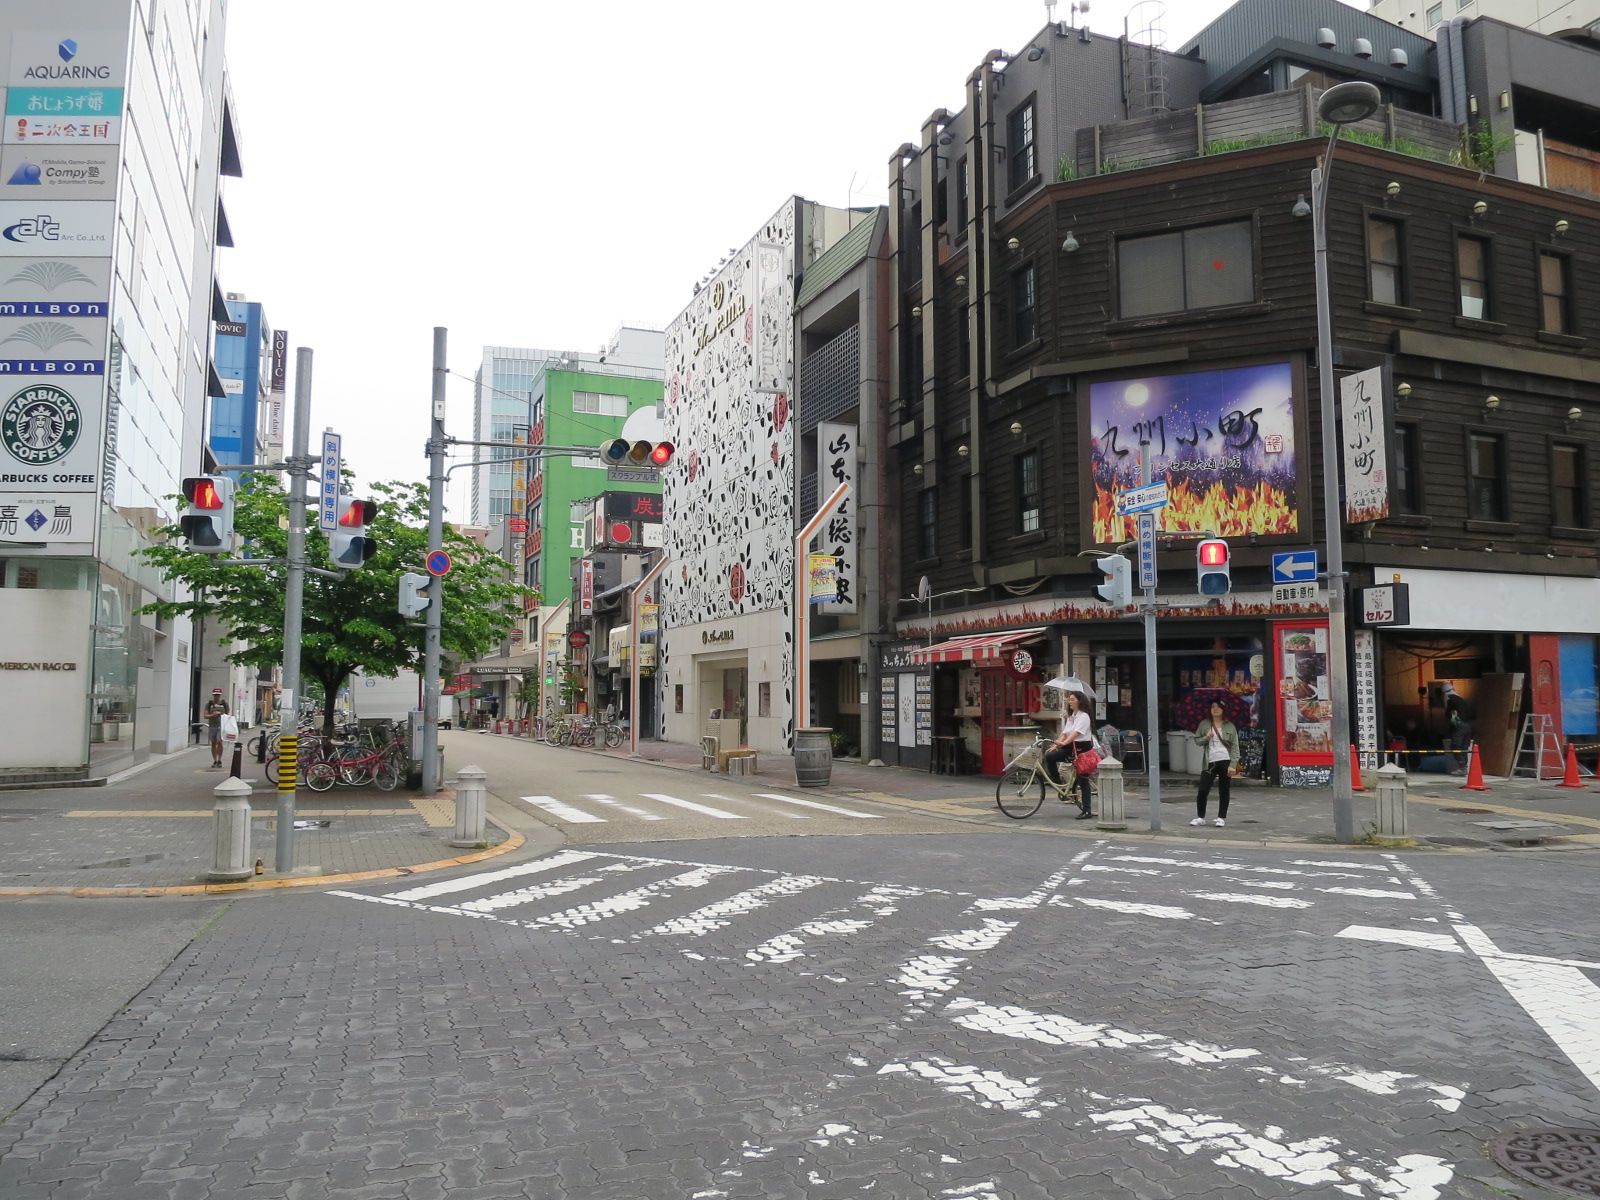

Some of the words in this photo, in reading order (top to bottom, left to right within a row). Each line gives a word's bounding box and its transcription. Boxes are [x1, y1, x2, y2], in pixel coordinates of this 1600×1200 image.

[24, 65, 111, 80] AQUARING
[33, 121, 111, 139] 二次会王国
[275, 331, 286, 377] NOVIC
[5, 389, 78, 423] STARBUCKS
[1101, 408, 1263, 458] 九州小町
[1350, 376, 1376, 476] 九州小町
[12, 441, 67, 461] COFFEE
[53, 474, 95, 483] COFFEE
[324, 441, 337, 523] 斜め横断専用
[611, 471, 657, 482] スクランブル式
[1141, 520, 1154, 582] 斜め横断専用
[1276, 586, 1314, 601] 自動車・原付
[1365, 610, 1393, 622] セルフ
[43, 662, 62, 671] RAG
